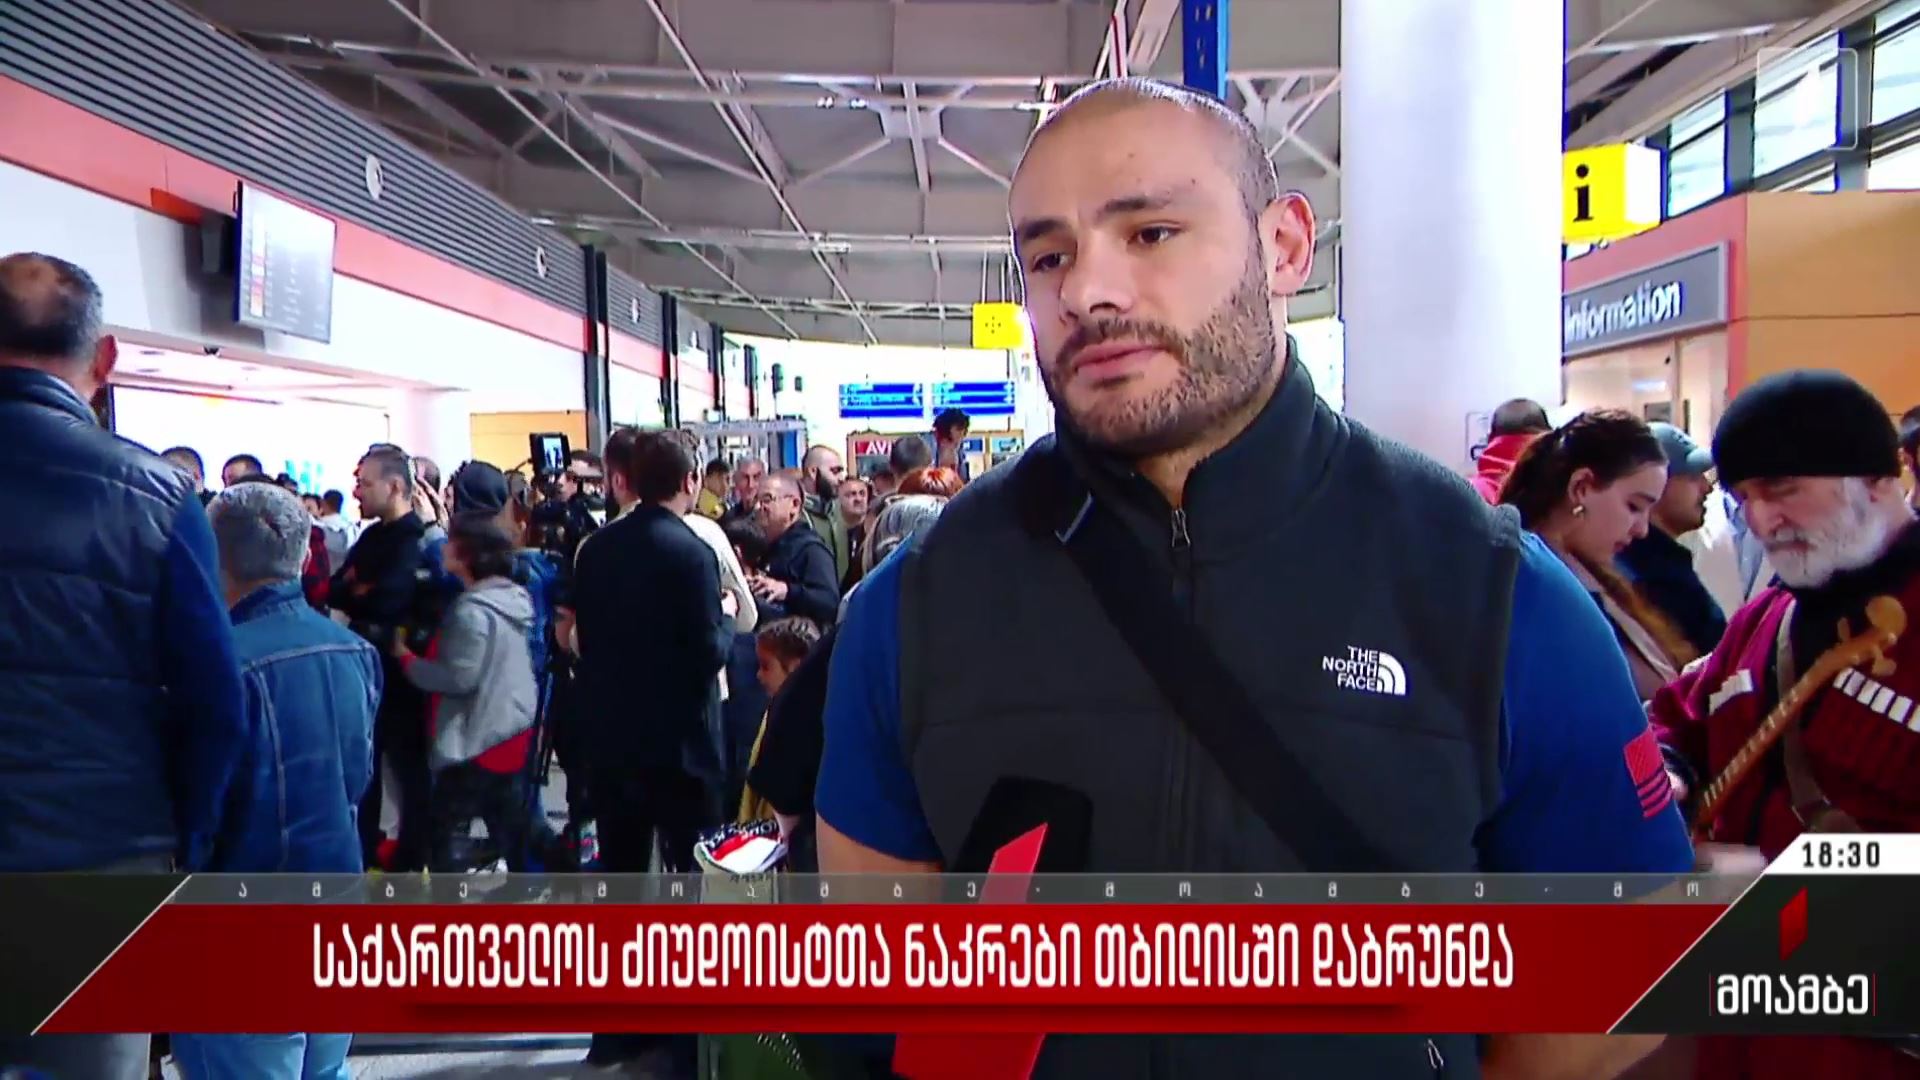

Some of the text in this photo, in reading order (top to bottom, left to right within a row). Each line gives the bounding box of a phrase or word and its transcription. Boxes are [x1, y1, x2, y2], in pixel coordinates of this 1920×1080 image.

[865, 440, 892, 456] AVI
[1347, 645, 1378, 663] THE
[1322, 655, 1378, 678] NORTH
[1337, 673, 1378, 692] FACE
